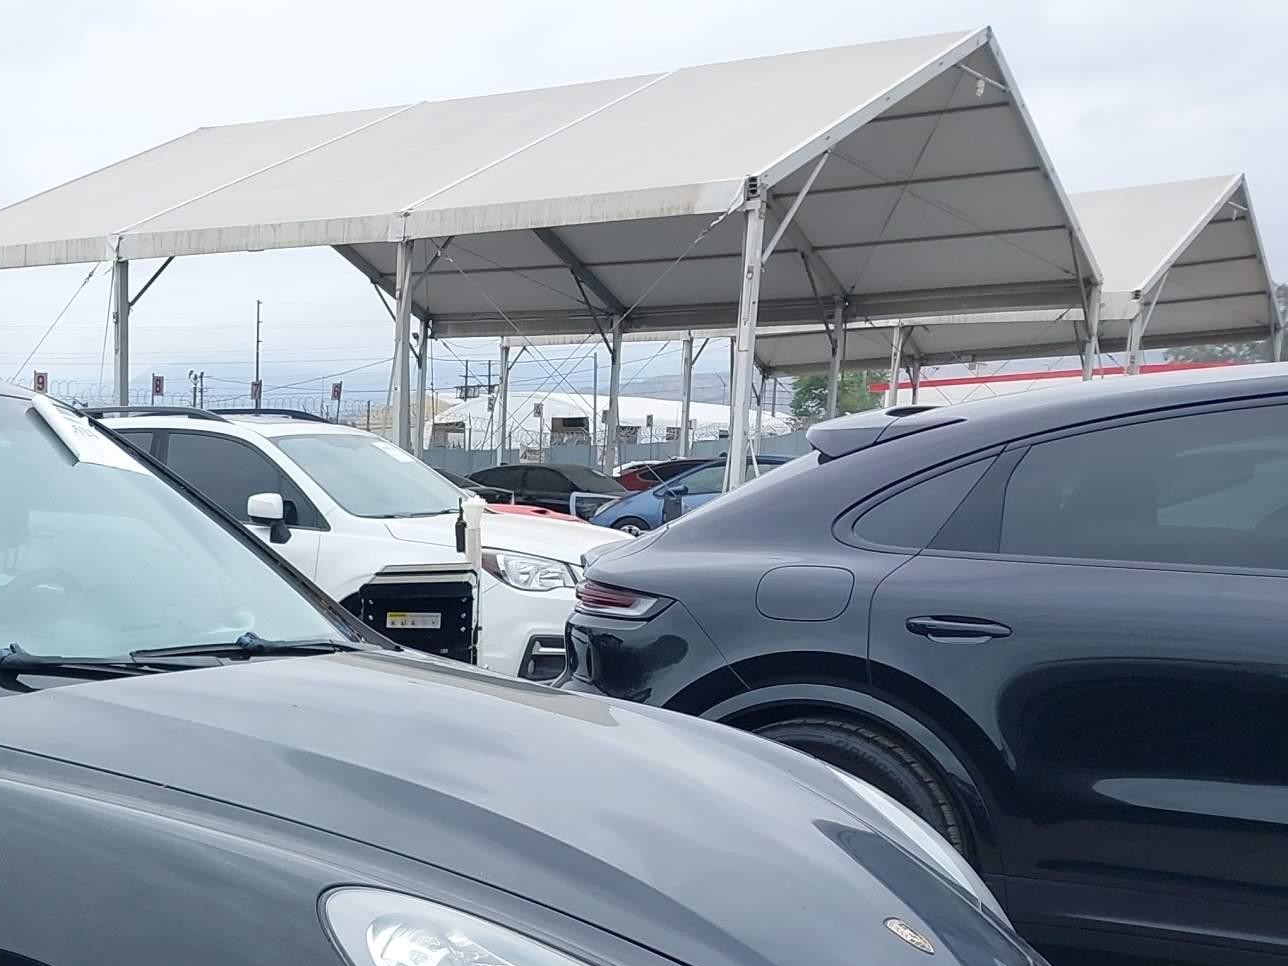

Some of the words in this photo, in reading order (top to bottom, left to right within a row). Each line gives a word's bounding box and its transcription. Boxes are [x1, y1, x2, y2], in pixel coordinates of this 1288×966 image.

[37, 374, 45, 391] 9
[155, 378, 161, 394] 8
[253, 383, 260, 398] 7
[333, 384, 339, 399] 6
